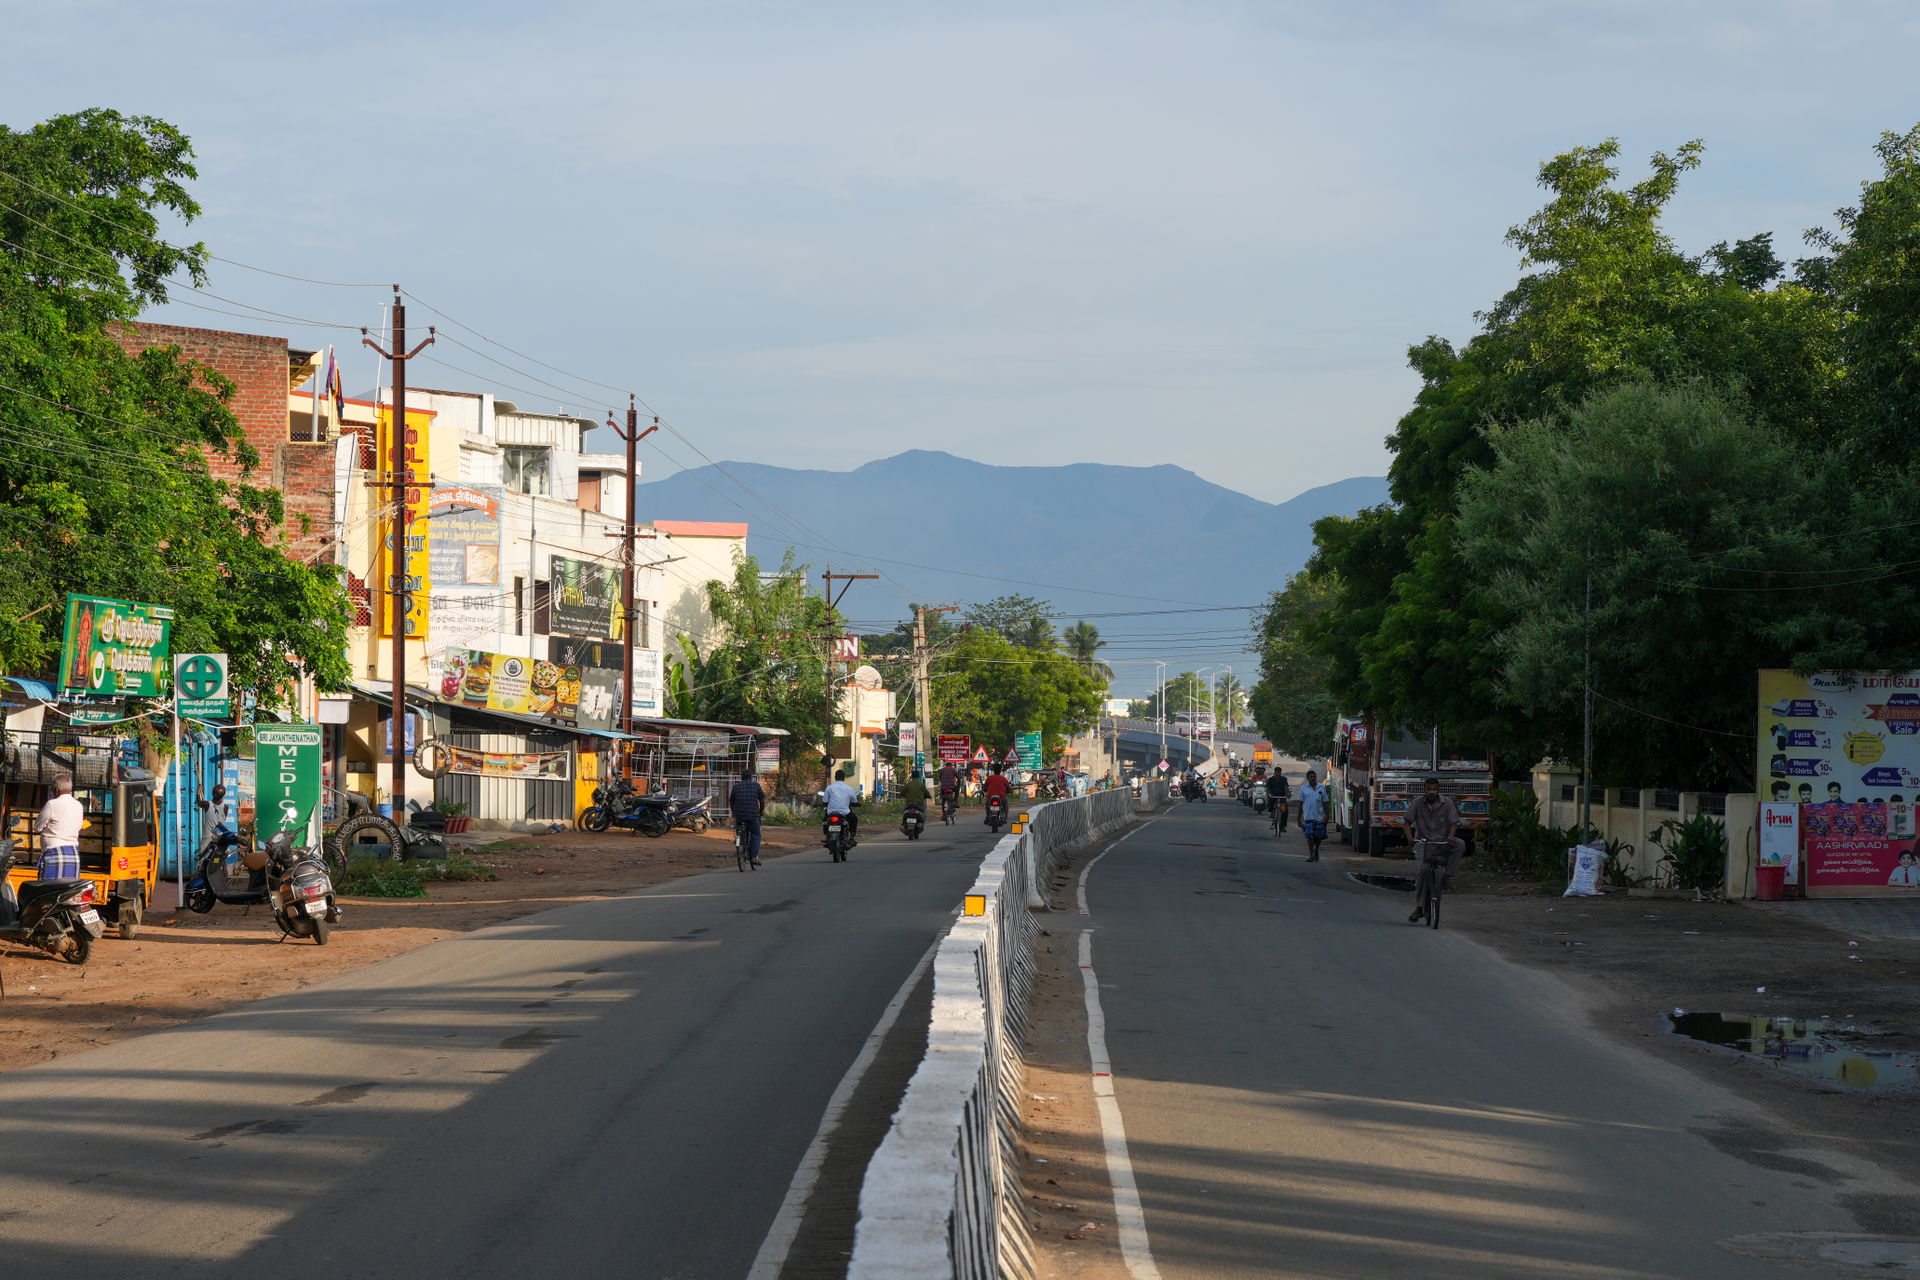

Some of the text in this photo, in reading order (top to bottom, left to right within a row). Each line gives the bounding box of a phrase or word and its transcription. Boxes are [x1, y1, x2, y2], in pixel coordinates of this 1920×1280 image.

[1895, 727, 1913, 735] Sale
[259, 732, 318, 743] SRI JAYANTHENATHAN
[1790, 767, 1813, 775] T-Shirts
[1766, 809, 1792, 827] Arun
[1816, 841, 1882, 849] AASHIRVAAD
